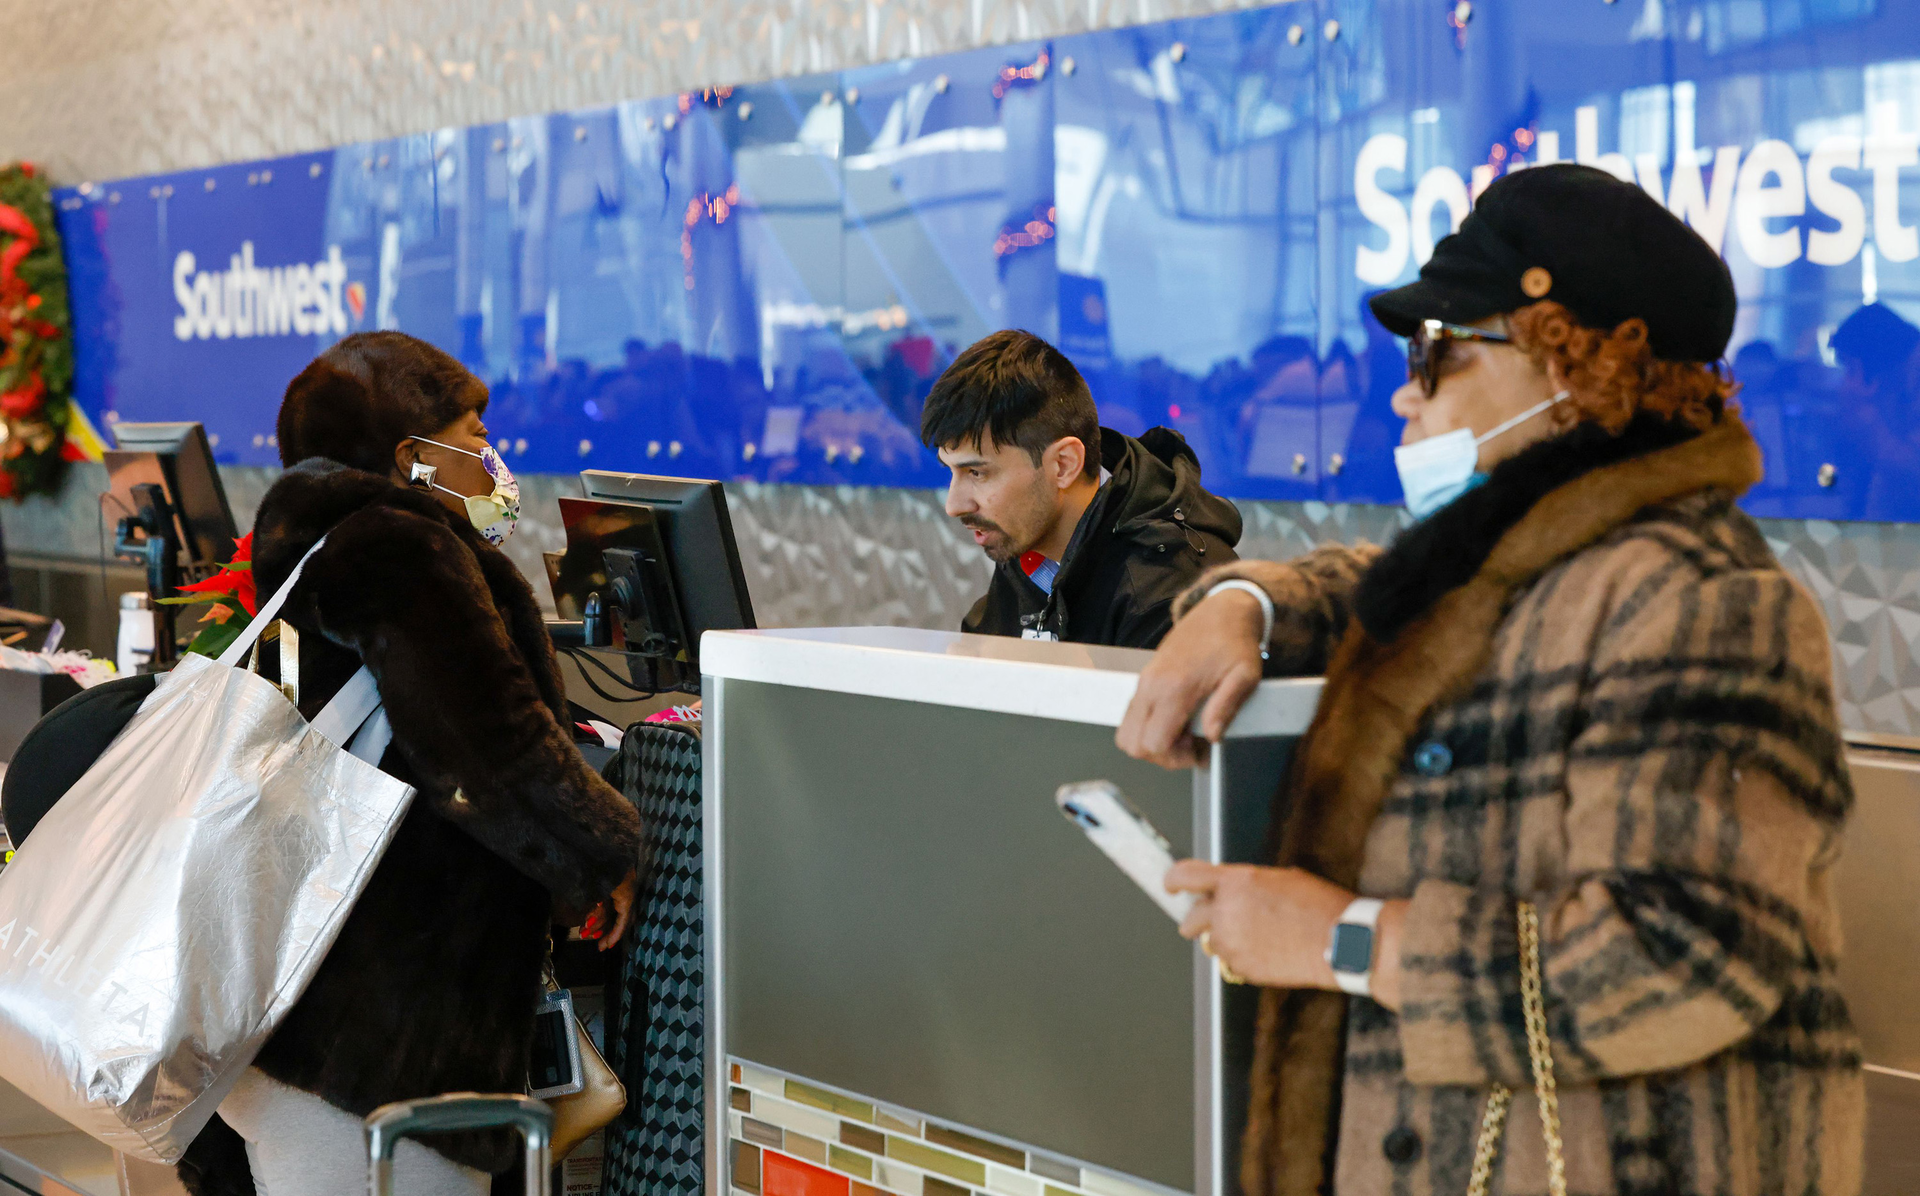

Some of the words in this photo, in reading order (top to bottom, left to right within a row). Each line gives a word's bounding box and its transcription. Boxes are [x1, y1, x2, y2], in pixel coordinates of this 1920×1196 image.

[1354, 100, 1919, 285] Sowest
[173, 239, 347, 340] Southwest
[0, 917, 150, 1038] ATHLETA
